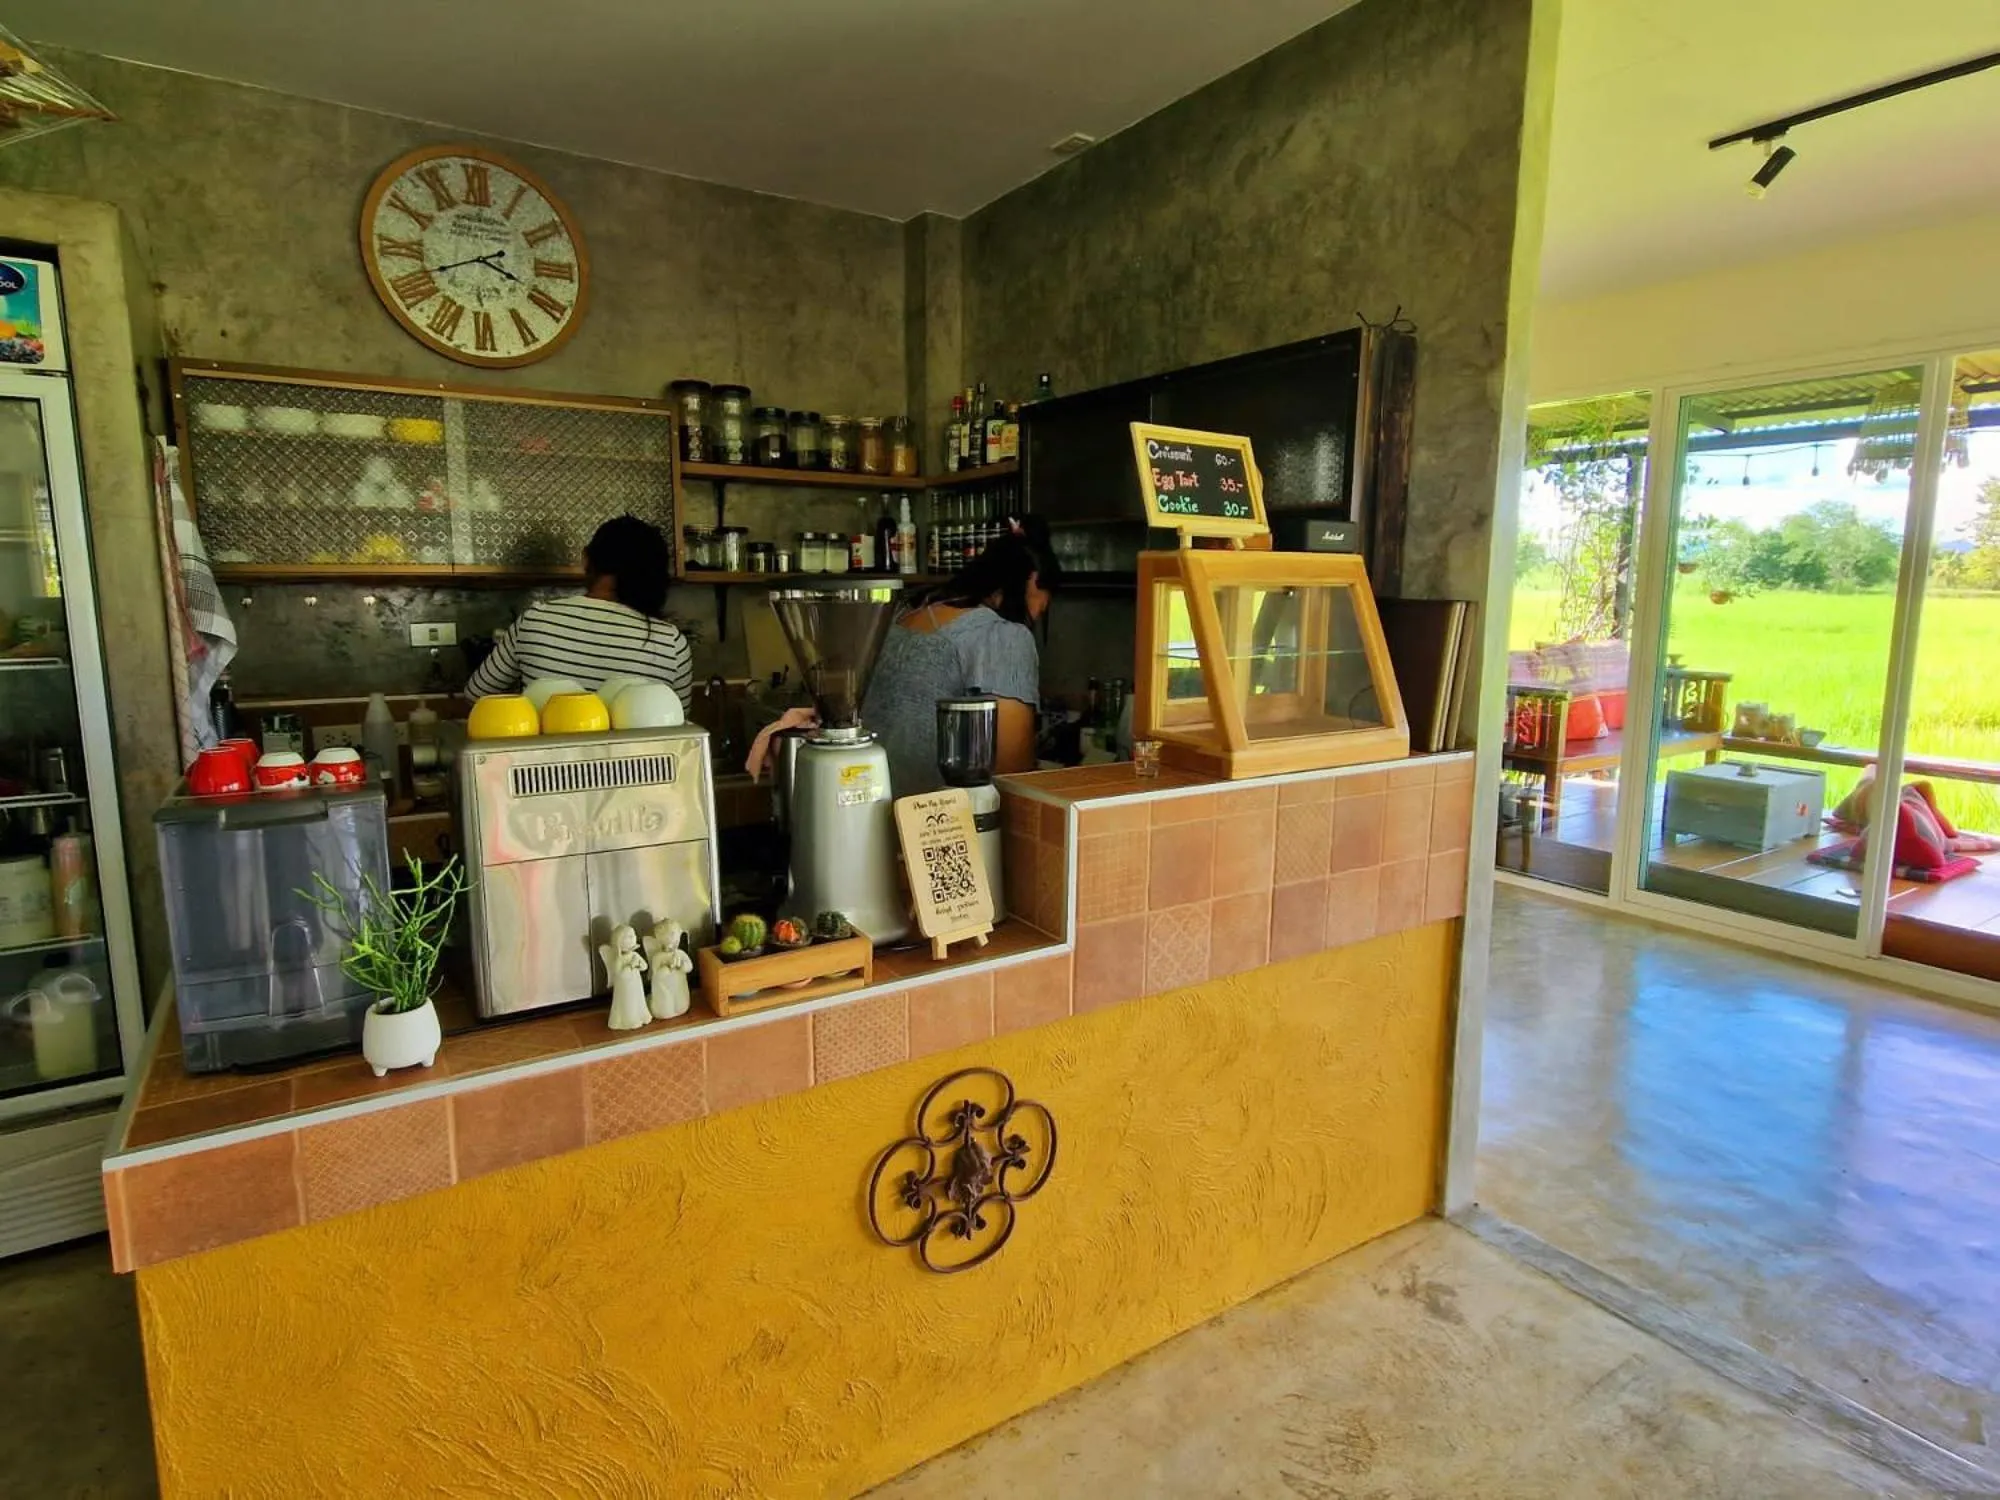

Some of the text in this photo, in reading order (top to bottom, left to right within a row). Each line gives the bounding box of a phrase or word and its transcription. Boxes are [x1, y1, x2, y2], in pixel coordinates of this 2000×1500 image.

[416, 165, 459, 211] XI
[461, 163, 492, 207] XII
[502, 184, 528, 220] I
[386, 192, 435, 231] X
[377, 233, 424, 261] IX
[522, 219, 562, 248] II
[534, 257, 573, 283] III
[389, 270, 439, 310] VIII
[427, 295, 465, 342] VII
[472, 311, 498, 352] VI
[508, 307, 540, 347] V
[1152, 468, 1175, 490] Egg
[1176, 470, 1200, 487] Tart
[1158, 494, 1199, 512] Cookie
